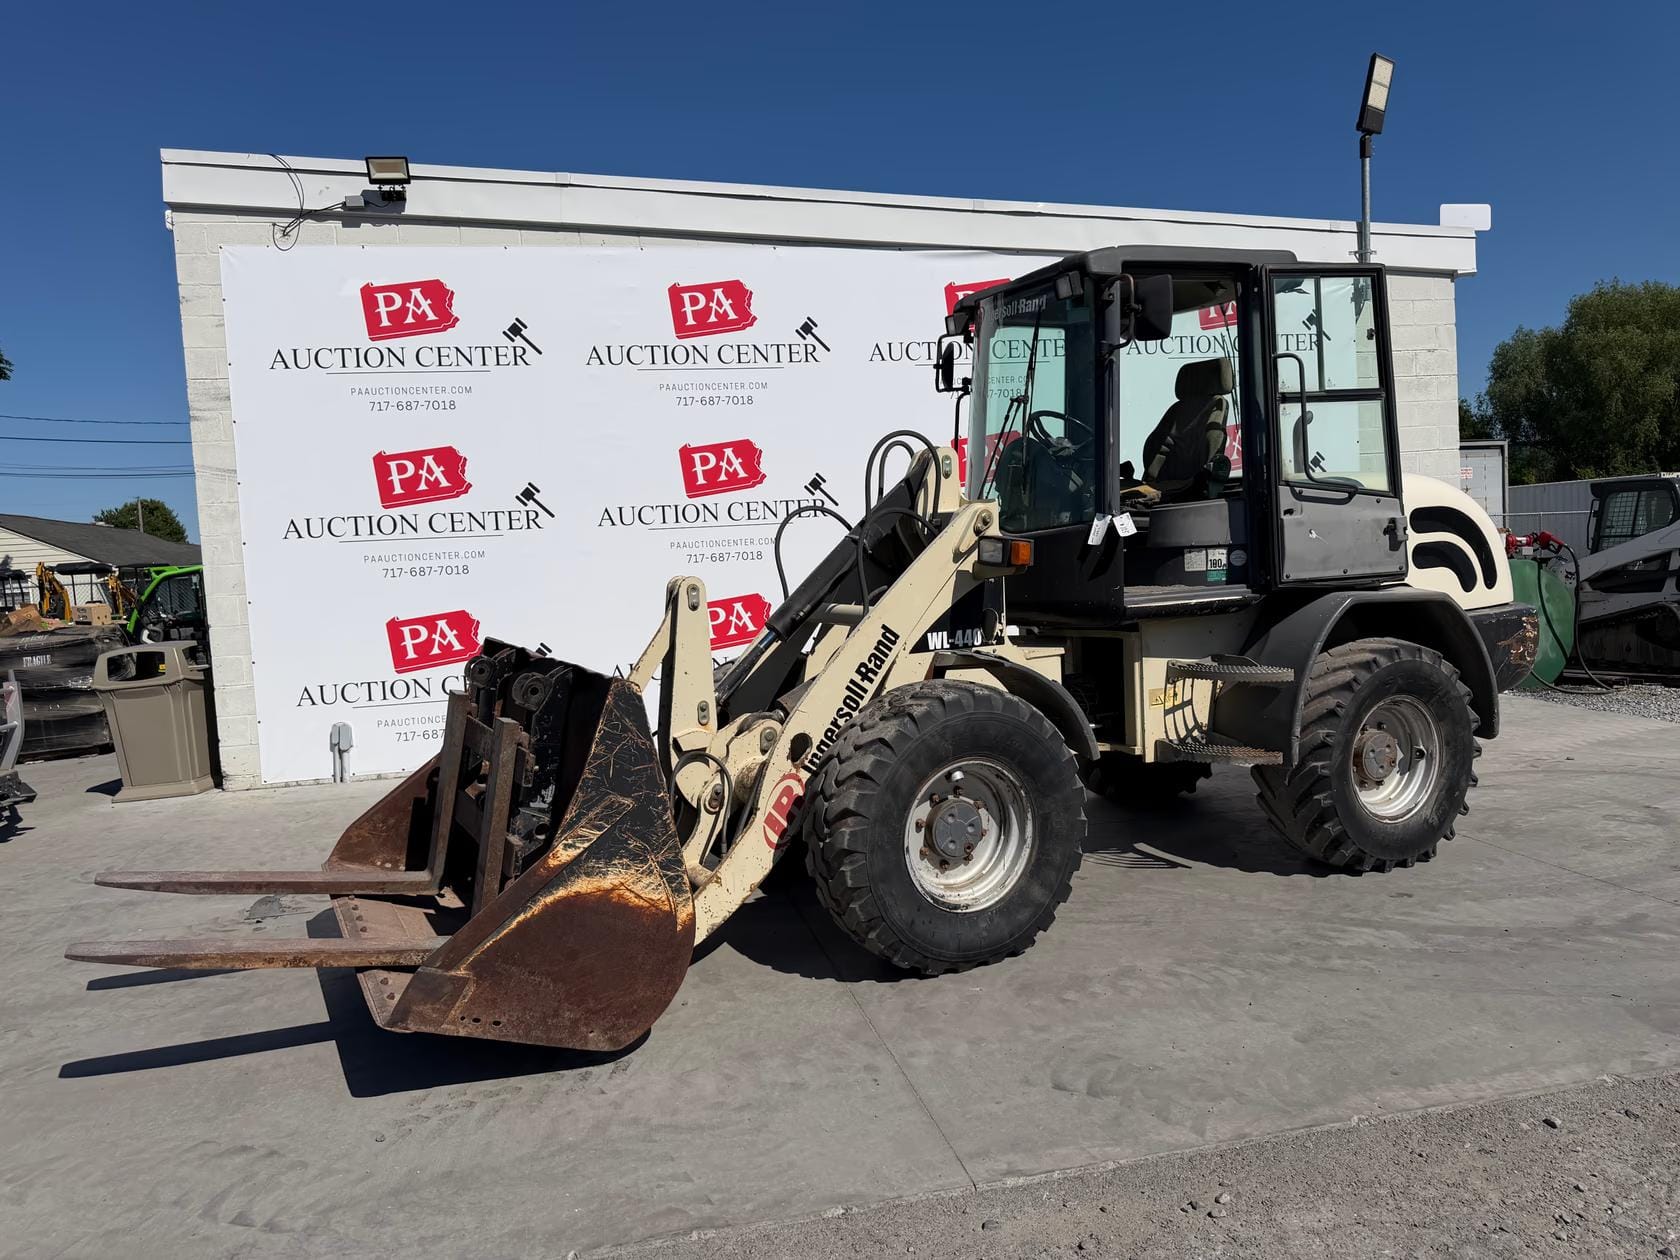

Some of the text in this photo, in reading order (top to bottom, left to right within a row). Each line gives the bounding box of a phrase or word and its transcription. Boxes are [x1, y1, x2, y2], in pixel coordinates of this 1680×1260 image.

[374, 287, 439, 328] PA
[680, 287, 740, 327] PA
[269, 344, 532, 370] AUCTION CENTER
[585, 342, 821, 366] AUCTION CENTER
[869, 338, 1067, 363] AUCTON CENTE
[350, 385, 473, 397] PAAUCTIONCENTER.COM
[658, 381, 769, 392] PAAUCTIONCENTER.COM
[369, 400, 457, 412] 717-687-7018
[675, 395, 754, 407] 717-687-7018
[386, 454, 452, 495] PA
[691, 447, 749, 486] PA
[282, 509, 544, 540] AUCTION CENTER
[597, 498, 829, 527] AUCTION CENTER
[363, 550, 486, 563] PAAUCTIONCENTER.COM
[686, 551, 764, 564] 717-687-7018
[382, 565, 470, 578] 717-687-7018
[707, 601, 758, 639] PA
[399, 618, 465, 660] PA
[926, 627, 982, 650] WL-440
[296, 677, 432, 707] AUCTION
[377, 714, 447, 728] PAAUCTIONCE
[395, 728, 446, 743] 717-687
